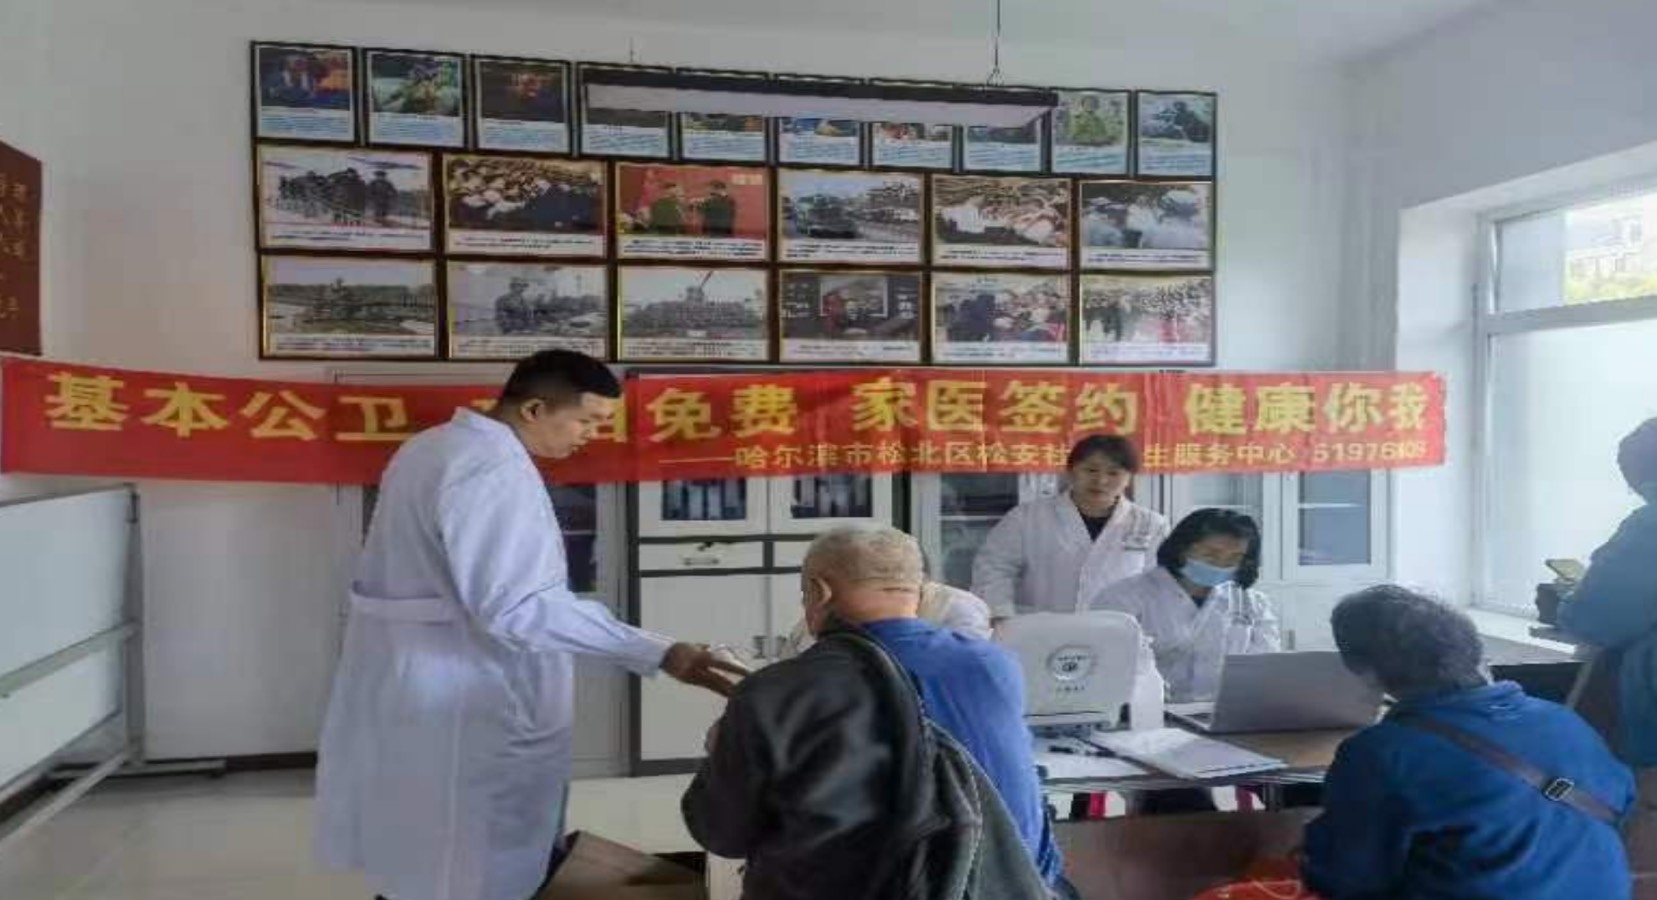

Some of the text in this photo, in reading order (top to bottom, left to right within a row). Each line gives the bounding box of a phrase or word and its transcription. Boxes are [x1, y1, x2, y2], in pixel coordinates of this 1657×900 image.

[45, 373, 413, 442] 基本公卫
[851, 375, 1138, 435] 家医签约
[1183, 381, 1427, 433] 健康你我
